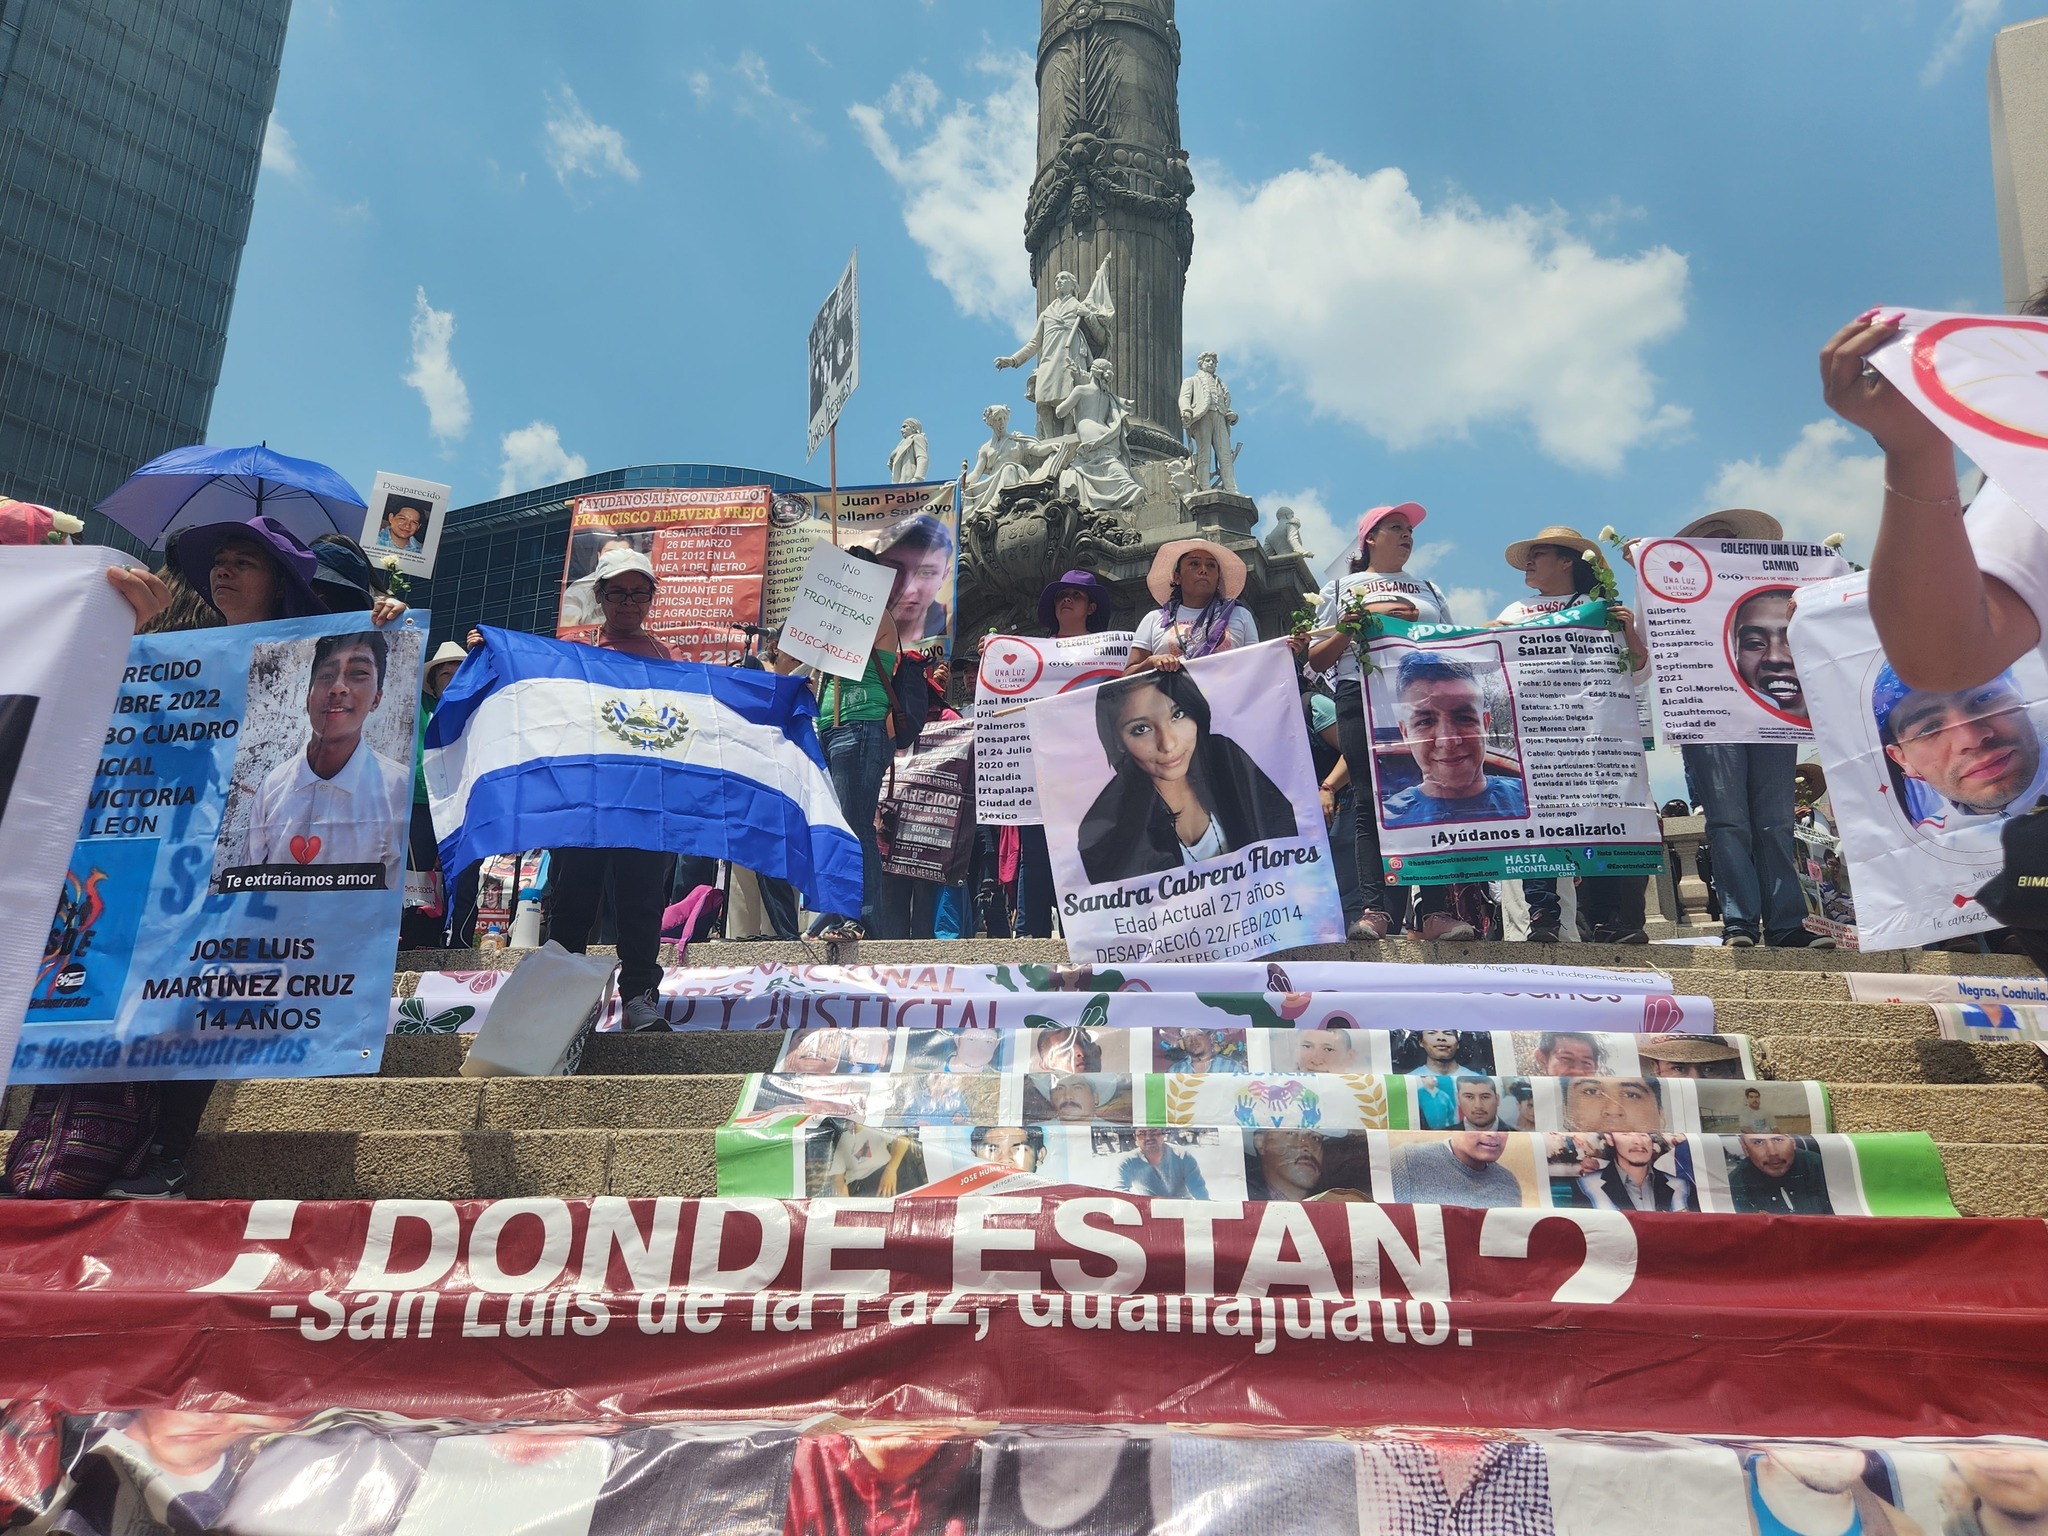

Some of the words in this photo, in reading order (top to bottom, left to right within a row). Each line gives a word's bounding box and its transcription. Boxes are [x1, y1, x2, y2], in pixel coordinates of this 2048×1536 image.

[382, 481, 441, 500] Desaparecido
[651, 494, 660, 505] A
[842, 494, 880, 507] Juan
[886, 492, 930, 504] Pablo
[574, 510, 650, 526] FRANCISCO
[652, 507, 721, 522] ALBAVERA
[724, 506, 767, 522] TREJO
[889, 504, 952, 517] Santoyo
[659, 528, 727, 538] DESAPARECIO
[730, 526, 742, 536] EL
[667, 540, 678, 548] 26
[680, 540, 694, 548] DE
[696, 539, 732, 548] MARZO
[1721, 542, 1768, 555] COLECTIVO
[1771, 543, 1790, 556] UNA
[1792, 544, 1808, 556] LUZ
[1810, 544, 1822, 556] EN
[661, 552, 680, 560] DEL
[682, 552, 704, 560] 2012
[707, 551, 721, 560] EN
[723, 551, 736, 560] LA
[651, 562, 678, 572] LINEA
[690, 562, 709, 572] DEL
[711, 562, 746, 571] METRO
[768, 558, 788, 566] Edad
[1762, 560, 1799, 572] CAMINO
[768, 566, 804, 576] Estatura:
[1663, 576, 1680, 584] UNA
[655, 586, 718, 595] ESTUDIANTE
[720, 586, 734, 594] DE
[817, 573, 874, 603] conocemos
[694, 597, 714, 606] DEL
[716, 596, 733, 606] IPN
[804, 588, 874, 626] FRONTERAS
[648, 610, 661, 618] SE
[663, 608, 734, 618] AGRADECERA
[1647, 606, 1686, 615] Gilberto
[820, 619, 842, 634] para
[1103, 634, 1120, 642] UNA
[1519, 634, 1562, 644] Carlos
[1564, 632, 1614, 644] Giovanni
[1650, 628, 1696, 638] González
[790, 626, 864, 664] BUSCARLES!
[1094, 646, 1128, 656] CAMINO
[1518, 645, 1566, 656] Salazar
[1570, 644, 1620, 654] Valencia
[1654, 652, 1664, 660] el
[994, 669, 1010, 677] UNA
[1012, 668, 1026, 676] LUZ
[1656, 662, 1714, 671] Septiembre
[1658, 674, 1683, 682] 2021
[1660, 686, 1672, 694] En
[1676, 685, 1738, 694] Col.Morelos,
[167, 688, 221, 710] 2022
[976, 698, 998, 706] Jael
[1664, 708, 1730, 718] Cuauhtemoc,
[977, 722, 1026, 731] Palmeros
[1666, 720, 1701, 729] Ciudad
[1704, 720, 1716, 728] de
[142, 719, 239, 744] CUADRO
[1668, 731, 1704, 740] México
[978, 748, 987, 756] el
[990, 748, 1004, 756] 24
[1006, 746, 1032, 754] Julio
[978, 761, 1004, 769] 2020
[978, 785, 1034, 796] Iztapalapa
[88, 786, 196, 810] VICTORIA
[879, 786, 962, 808] SPARECIDO!
[979, 798, 1016, 808] Ciudad
[1019, 798, 1032, 806] de
[924, 804, 932, 812] DE
[932, 806, 958, 816] ALVAREZ
[979, 811, 1018, 820] México
[90, 816, 158, 836] LEON
[1431, 828, 1520, 848] ¡Ayúdanos
[1526, 828, 1534, 838] a
[1540, 823, 1627, 838] localizarlo!
[1504, 854, 1546, 864] HASTA
[916, 866, 946, 881] HERRERA
[1506, 864, 1576, 874] ENCONTRARLES
[226, 874, 241, 888] Te
[244, 872, 334, 887] extrañamos
[336, 874, 376, 886] amor
[1064, 885, 1154, 916] Sandra
[1158, 860, 1247, 900] Cabrera
[1248, 844, 1322, 874] Flores
[1114, 916, 1158, 936] Edad
[1162, 896, 1217, 926] Actual
[1220, 892, 1242, 913] 27
[1246, 881, 1286, 905] años
[1932, 917, 1943, 930] Te
[1948, 910, 1989, 926] cansas
[1096, 927, 1201, 964] DESAPARECIÓ
[1205, 904, 1303, 946] 22/FEB/2014
[190, 937, 249, 962] JOSE
[258, 938, 315, 960] LUIS
[1225, 932, 1281, 960] EDO.MEX.
[1556, 970, 1654, 985] Independencia
[142, 974, 279, 1000] MARTINEZ
[287, 973, 355, 998] CRUZ
[1958, 983, 2000, 999] Negras,
[2001, 985, 2048, 1000] Coahuila.
[196, 1008, 228, 1031] 14
[234, 1003, 322, 1030] AÑOS
[720, 994, 742, 1030] Y
[42, 1036, 123, 1069] Hasta
[126, 1034, 311, 1070] Encontrarlos
[960, 1172, 978, 1186] JOSE
[270, 1290, 436, 1342] -San
[462, 1291, 610, 1338] Luis
[637, 1291, 725, 1335] de
[751, 1291, 813, 1332] la
[1018, 1290, 1473, 1354] Guanajuato.
